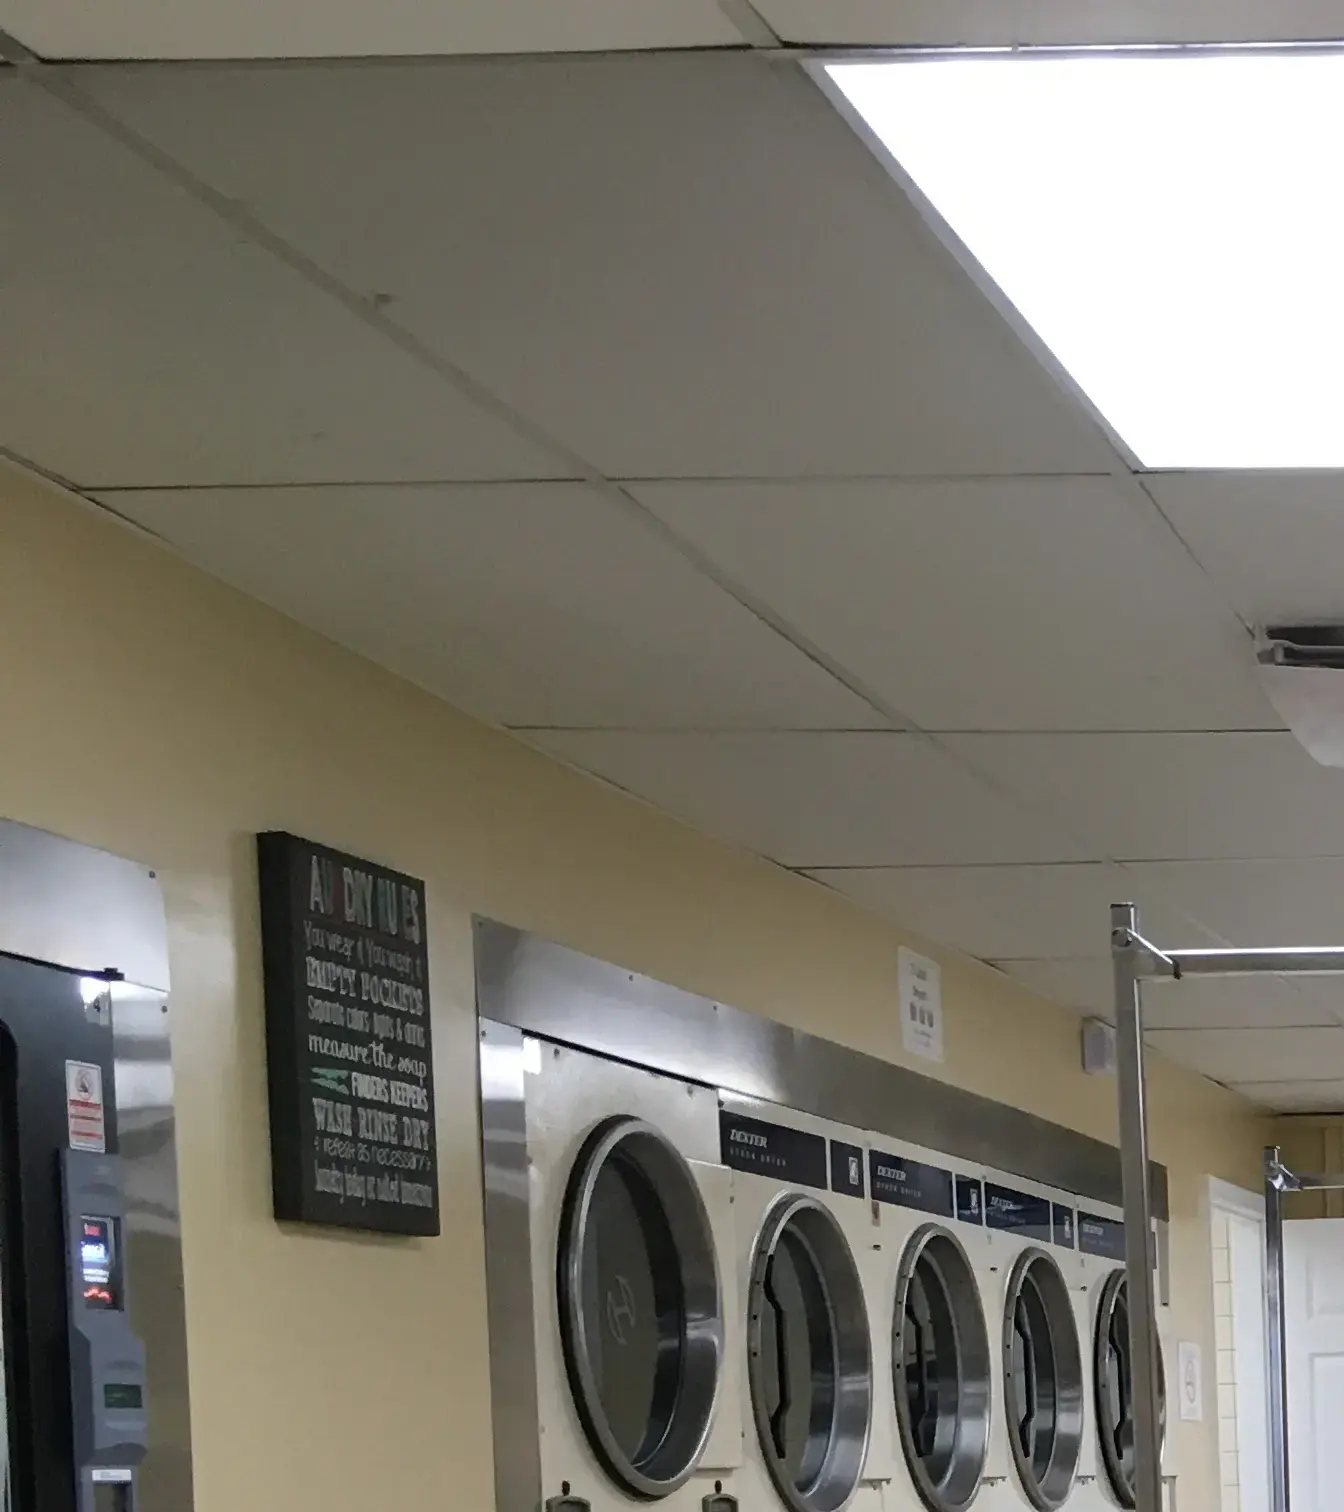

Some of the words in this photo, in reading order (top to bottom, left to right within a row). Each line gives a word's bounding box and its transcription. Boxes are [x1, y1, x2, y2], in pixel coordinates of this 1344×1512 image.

[306, 956, 356, 997] EMPTY
[361, 971, 424, 1016] POCKETS
[308, 1033, 371, 1065] measure
[370, 1041, 396, 1069] the
[397, 1056, 427, 1087] soap
[351, 1071, 389, 1103] FINDERS
[390, 1080, 428, 1112] KEEPERS
[312, 1097, 352, 1137] WASH
[357, 1106, 398, 1144] RINSE
[402, 1115, 429, 1150] DRY
[729, 1127, 768, 1149] DEXTER
[877, 1164, 907, 1183] DEXTER
